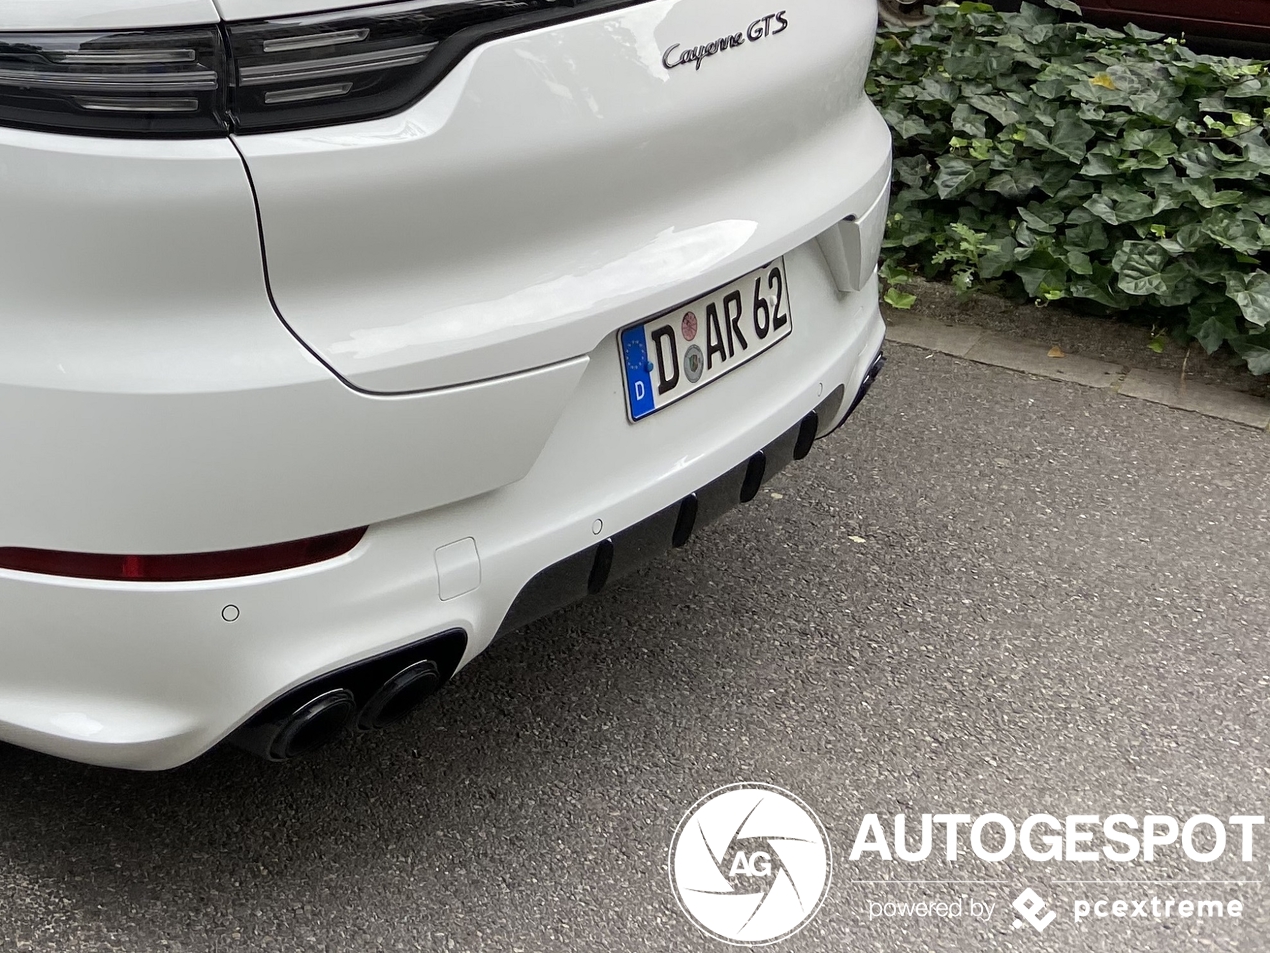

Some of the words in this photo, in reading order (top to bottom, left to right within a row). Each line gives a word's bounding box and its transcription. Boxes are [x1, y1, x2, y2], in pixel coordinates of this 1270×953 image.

[661, 31, 745, 71] Cayenne
[746, 10, 789, 43] GTS
[651, 324, 680, 395] D
[705, 289, 748, 371] AR
[753, 266, 788, 340] 62
[635, 380, 645, 401] D
